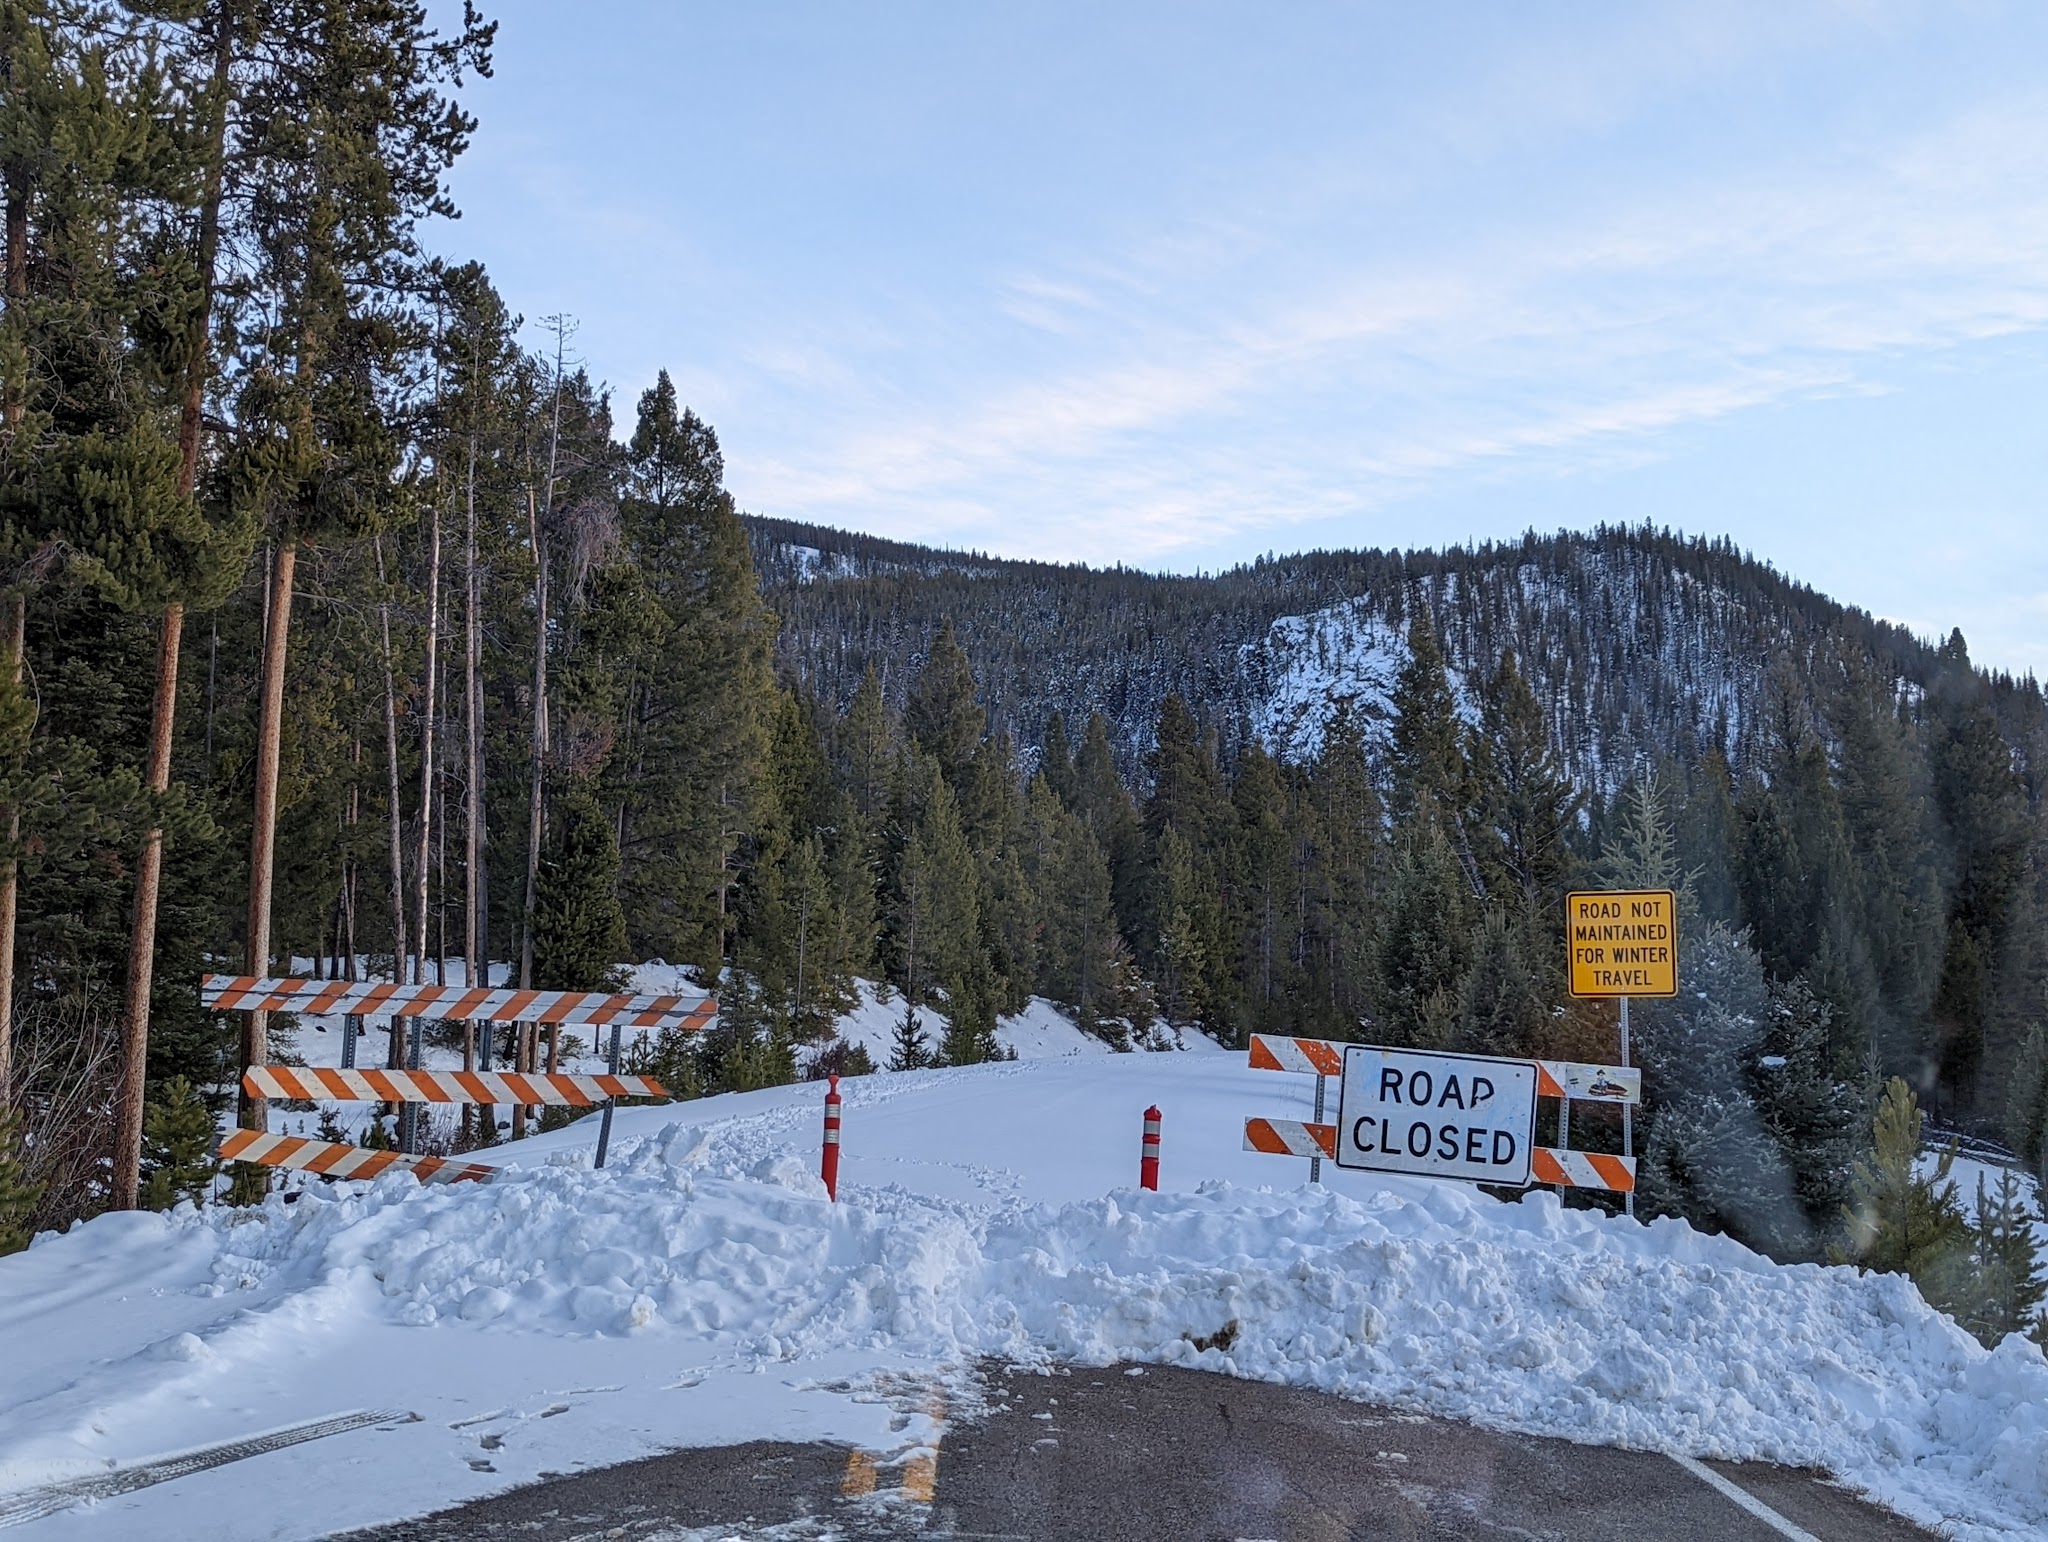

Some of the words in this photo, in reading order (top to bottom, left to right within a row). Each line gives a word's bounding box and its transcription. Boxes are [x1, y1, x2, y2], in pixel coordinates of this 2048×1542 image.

[1579, 903, 1621, 919] ROAD
[1631, 901, 1661, 918] NOT
[1576, 924, 1667, 941] MAINTAINED
[1576, 948, 1604, 964] FOR
[1612, 947, 1668, 963] WINTER
[1593, 970, 1653, 986] TRAVEL
[1352, 1116, 1516, 1165] CLOSED
